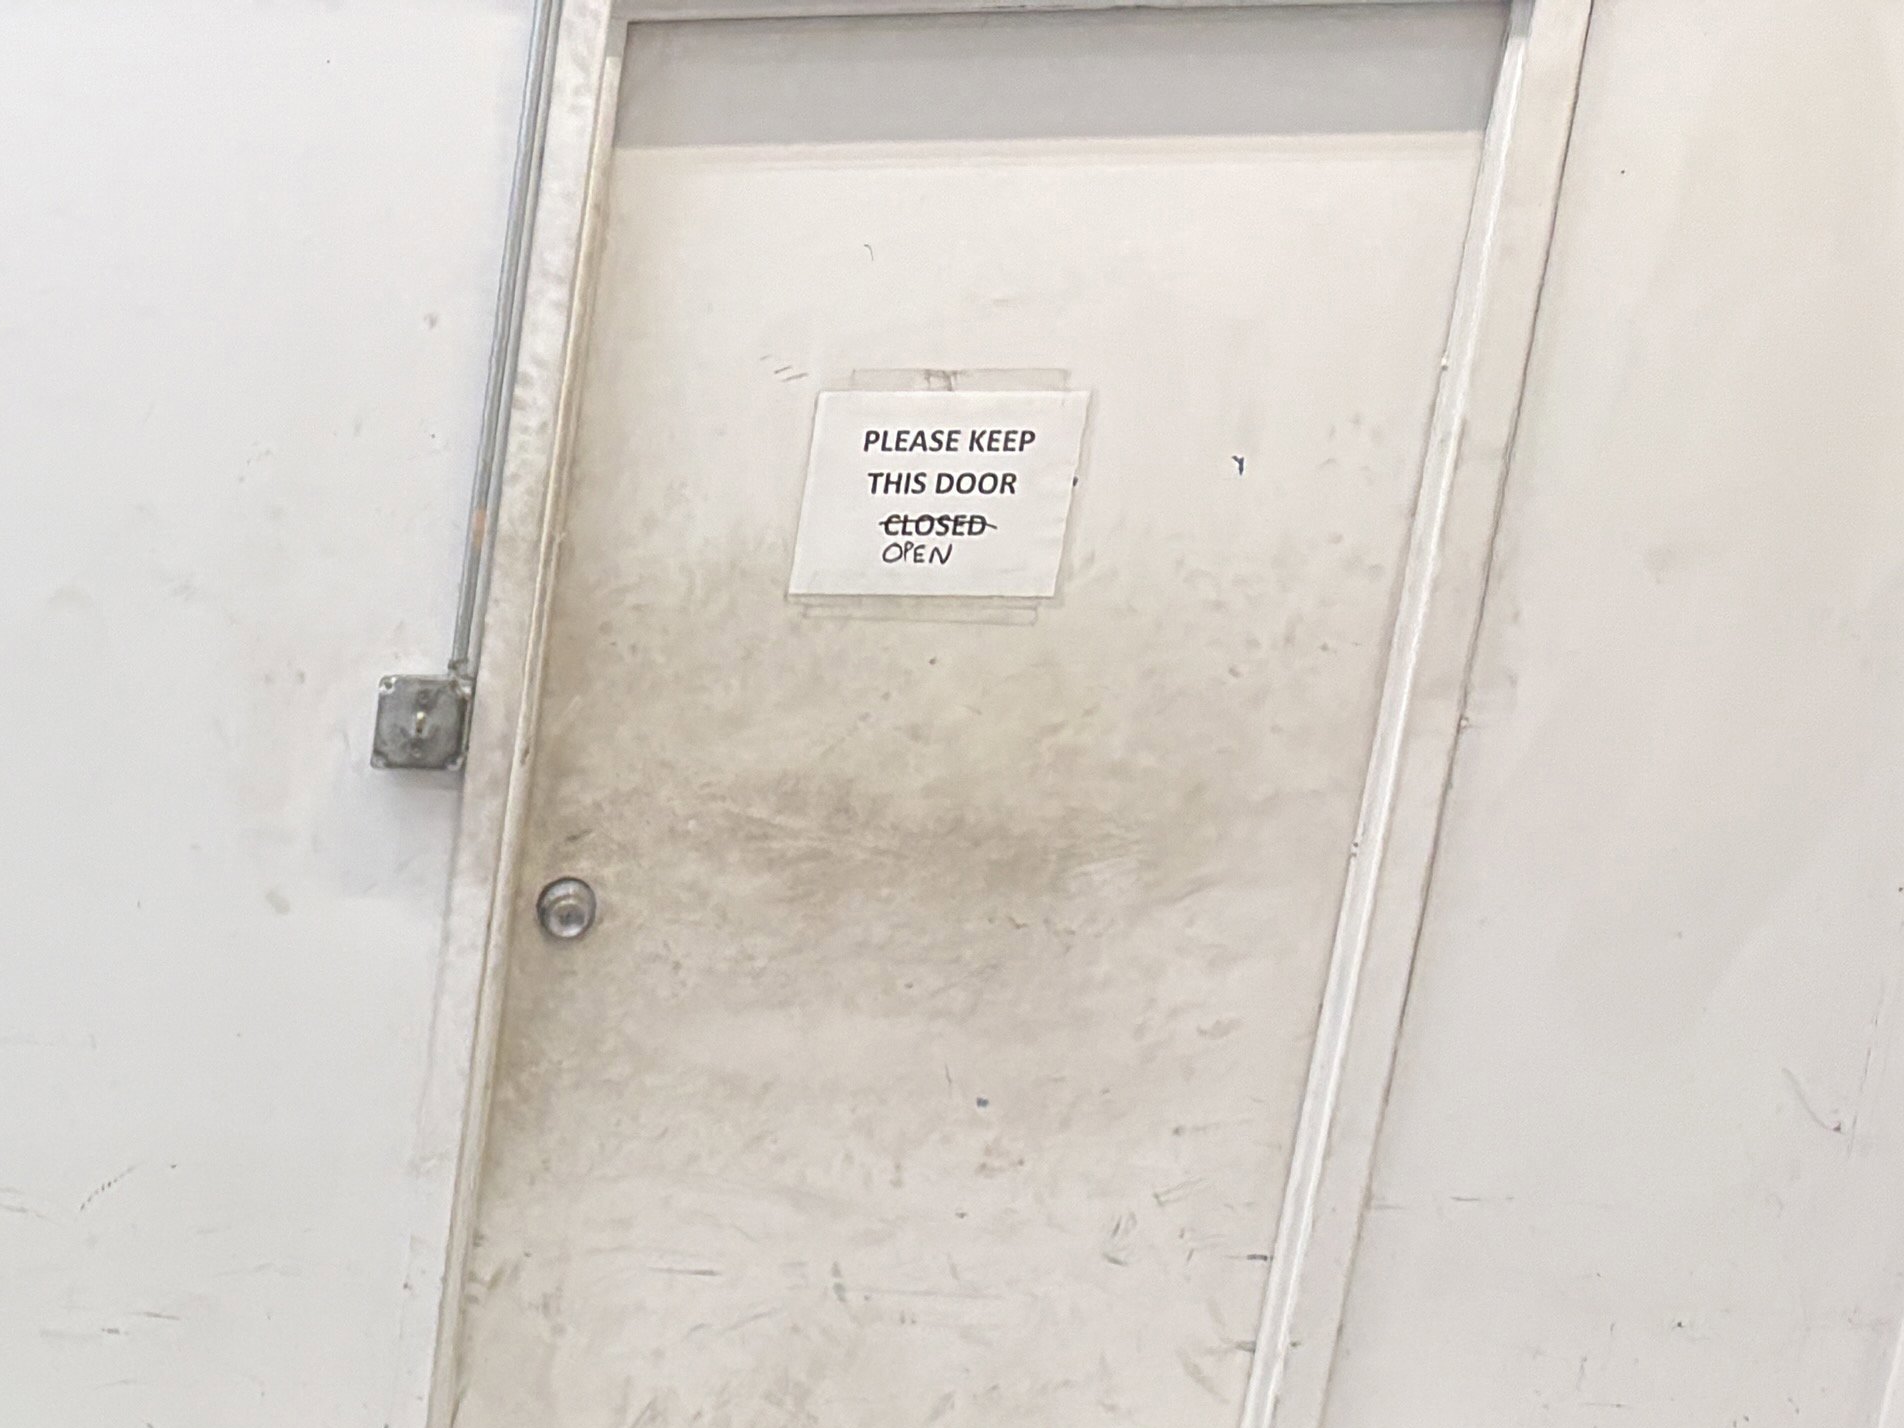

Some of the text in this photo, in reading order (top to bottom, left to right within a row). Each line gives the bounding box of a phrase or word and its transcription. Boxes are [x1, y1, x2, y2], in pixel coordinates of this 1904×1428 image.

[862, 429, 1036, 452] PLEASE KEEP
[867, 472, 1017, 494] THIS DOOR
[883, 514, 987, 536] CLOSED
[881, 540, 953, 564] OPEN
